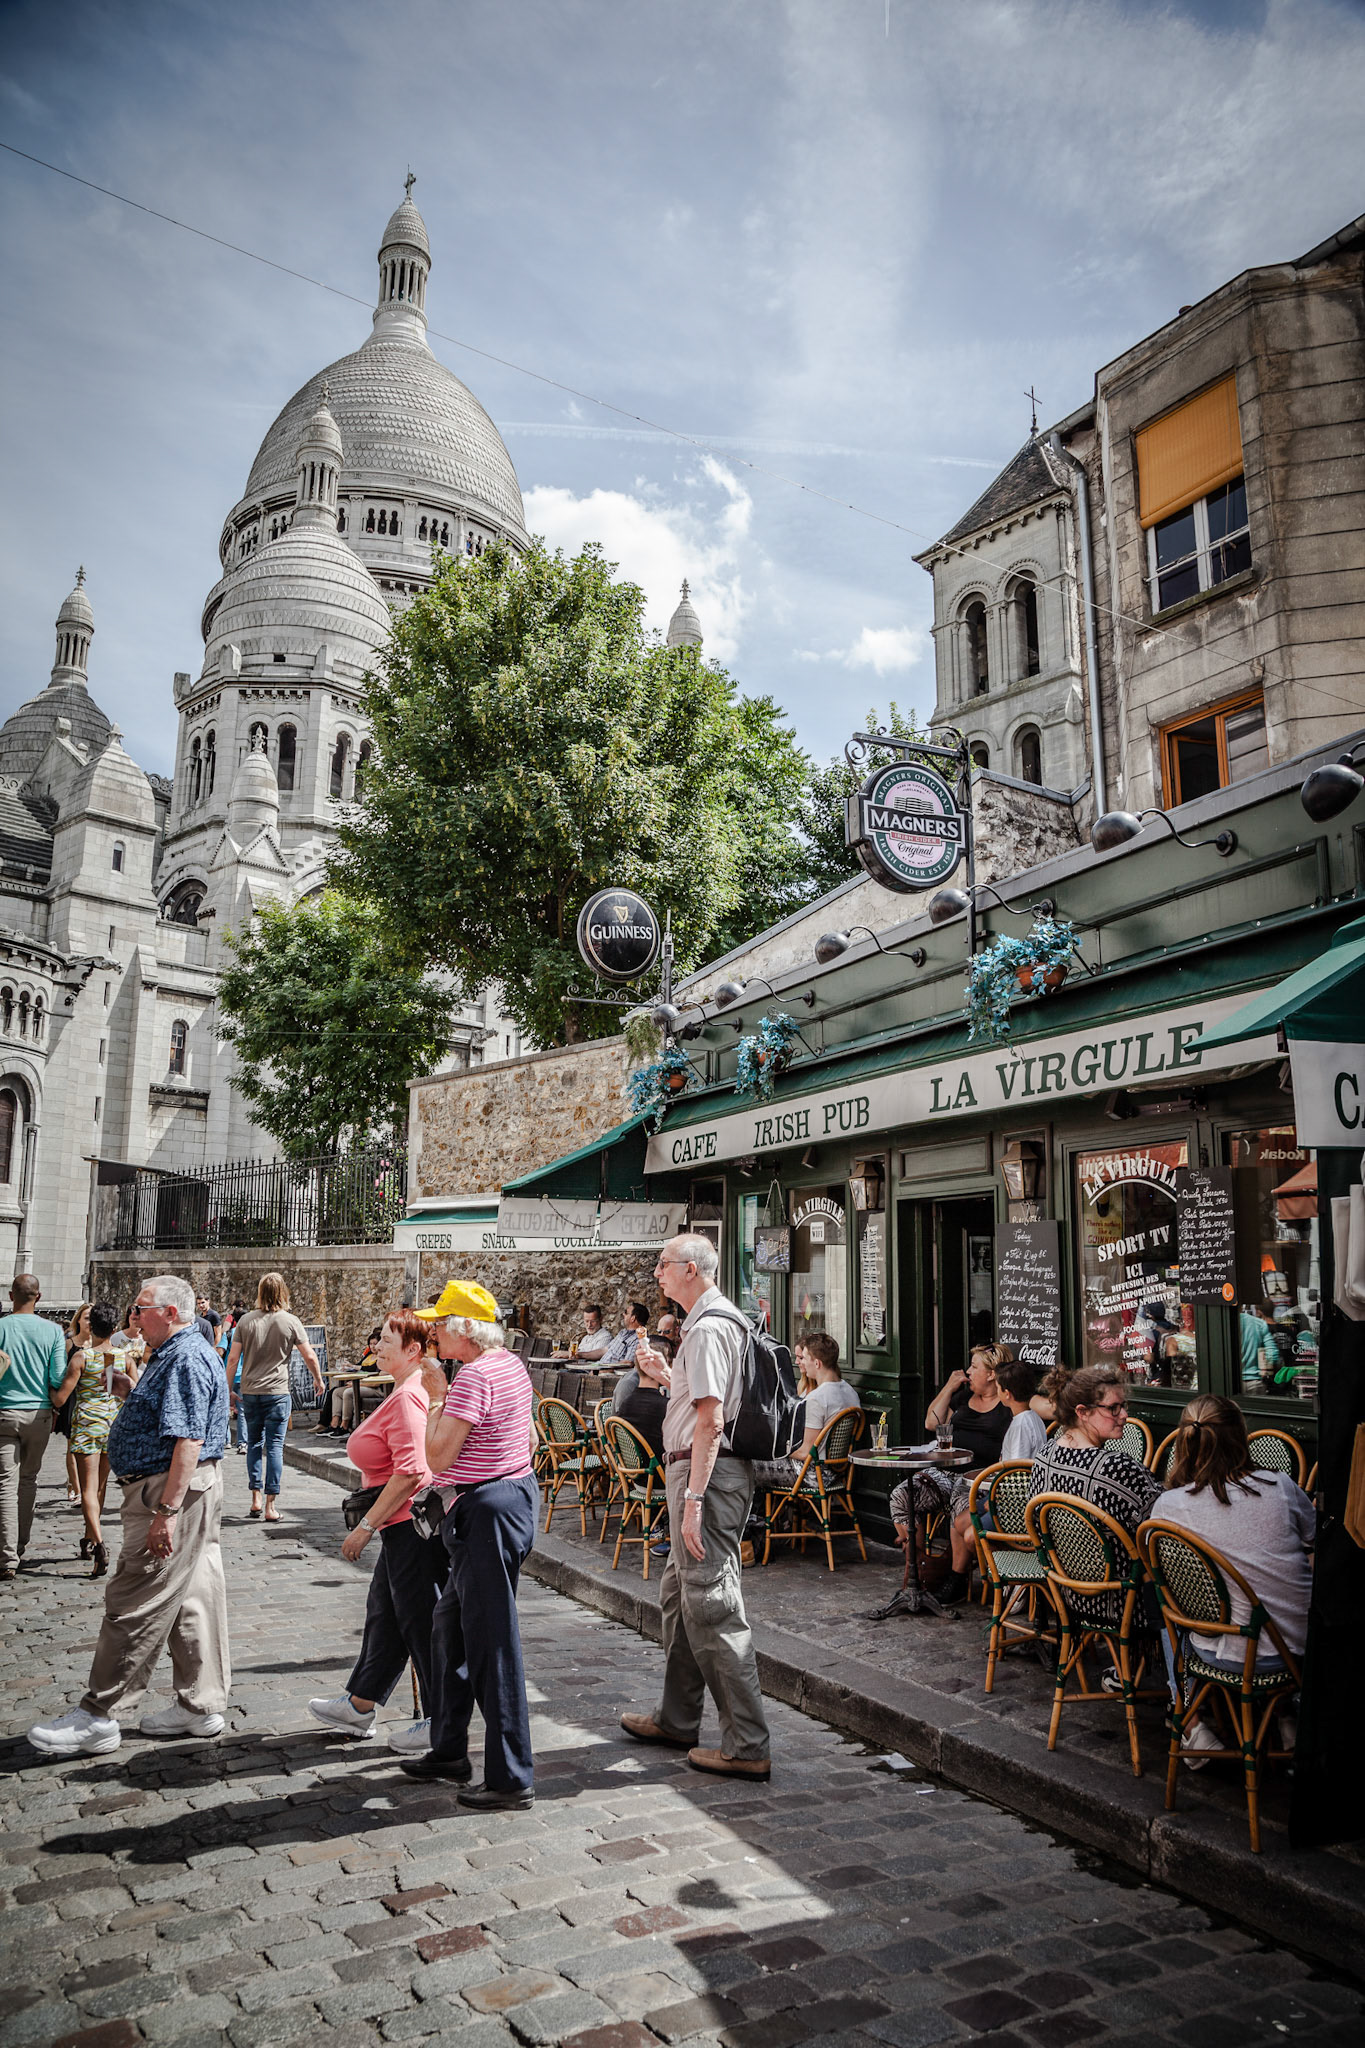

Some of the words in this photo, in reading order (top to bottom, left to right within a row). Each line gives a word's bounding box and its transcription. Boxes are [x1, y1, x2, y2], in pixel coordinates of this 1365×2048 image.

[878, 772, 911, 799] MAGNERS
[914, 773, 950, 810] ORIGINAL
[870, 808, 958, 838] MAGNERS
[880, 838, 897, 864] IRISH
[899, 864, 926, 876] CIDER
[898, 841, 934, 858] Original
[590, 924, 652, 940] GUINNESS
[929, 1072, 978, 1114] LA
[996, 1021, 1204, 1100] VIRGULE
[672, 1132, 718, 1164] CAFE
[753, 1108, 811, 1148] IRISH
[822, 1096, 870, 1134] PUB
[1083, 1172, 1105, 1199] LA
[792, 1206, 804, 1226] LA
[804, 1196, 844, 1222] VIRGULE
[416, 1234, 452, 1248] CREPES
[482, 1232, 516, 1248] SNACK
[1098, 1232, 1146, 1262] SPORT
[1150, 1224, 1170, 1246] TV
[1126, 1262, 1144, 1280] ICI
[1112, 1278, 1144, 1294] DIFFUSION
[1146, 1274, 1159, 1284] DES
[1122, 1282, 1167, 1302] IMPORTANTES
[1098, 1300, 1138, 1316] RENCONTRES
[1140, 1290, 1176, 1308] SPORTIVES
[1123, 1322, 1151, 1334] FOOTBALL
[1128, 1336, 1146, 1346] RUGBY
[1123, 1347, 1148, 1359] FORMULE
